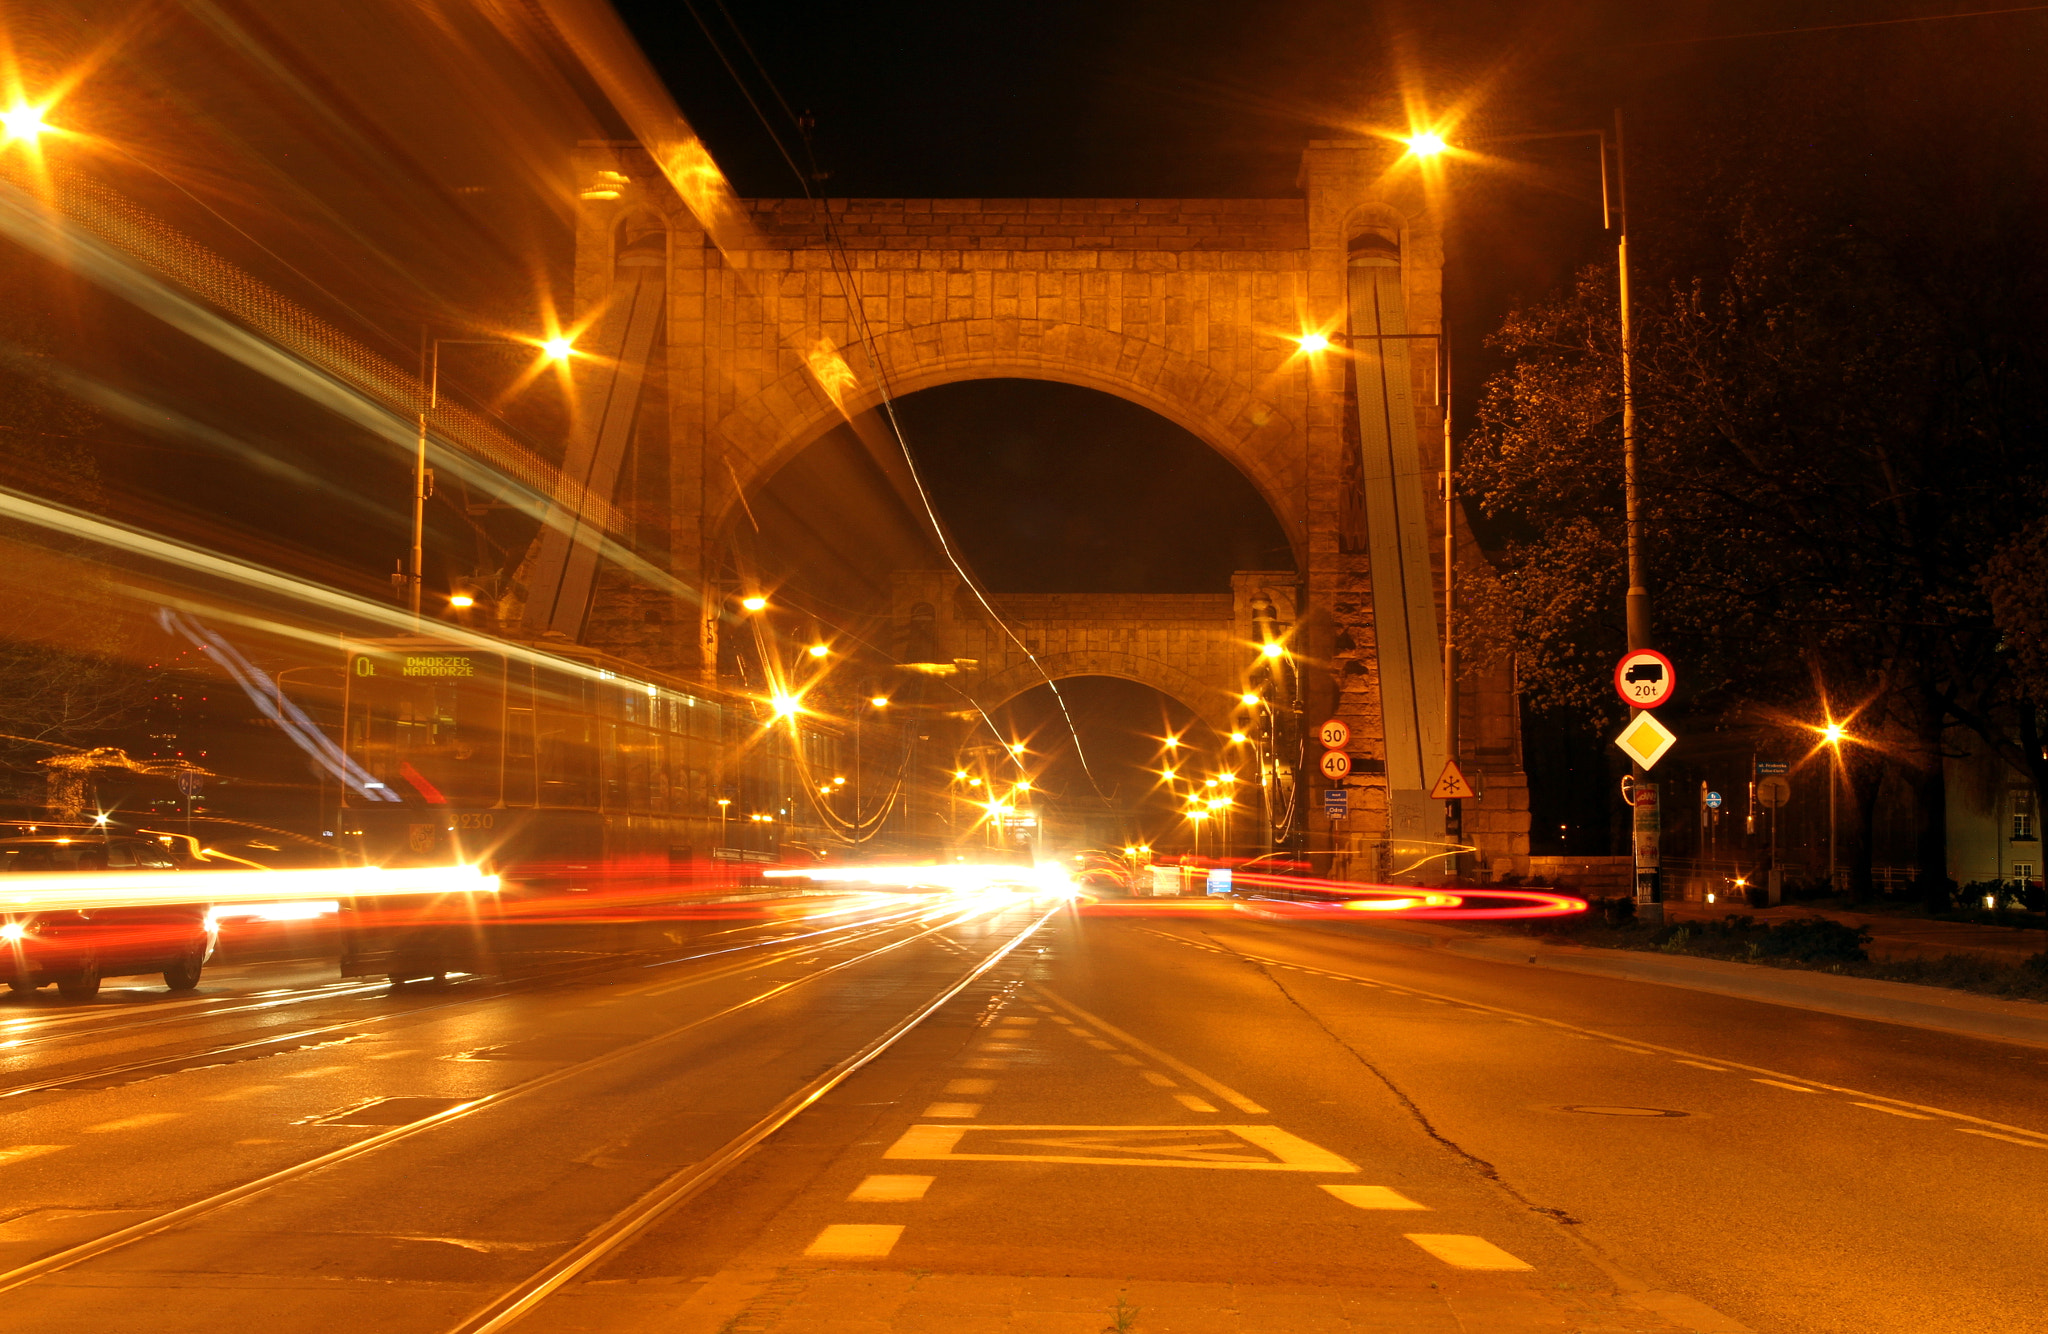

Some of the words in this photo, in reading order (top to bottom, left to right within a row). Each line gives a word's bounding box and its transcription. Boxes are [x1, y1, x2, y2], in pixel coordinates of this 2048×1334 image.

[406, 656, 470, 667] DWORZEC
[403, 666, 474, 677] NADODRZE
[1635, 685, 1657, 696] 20t
[1325, 757, 1346, 772] 40
